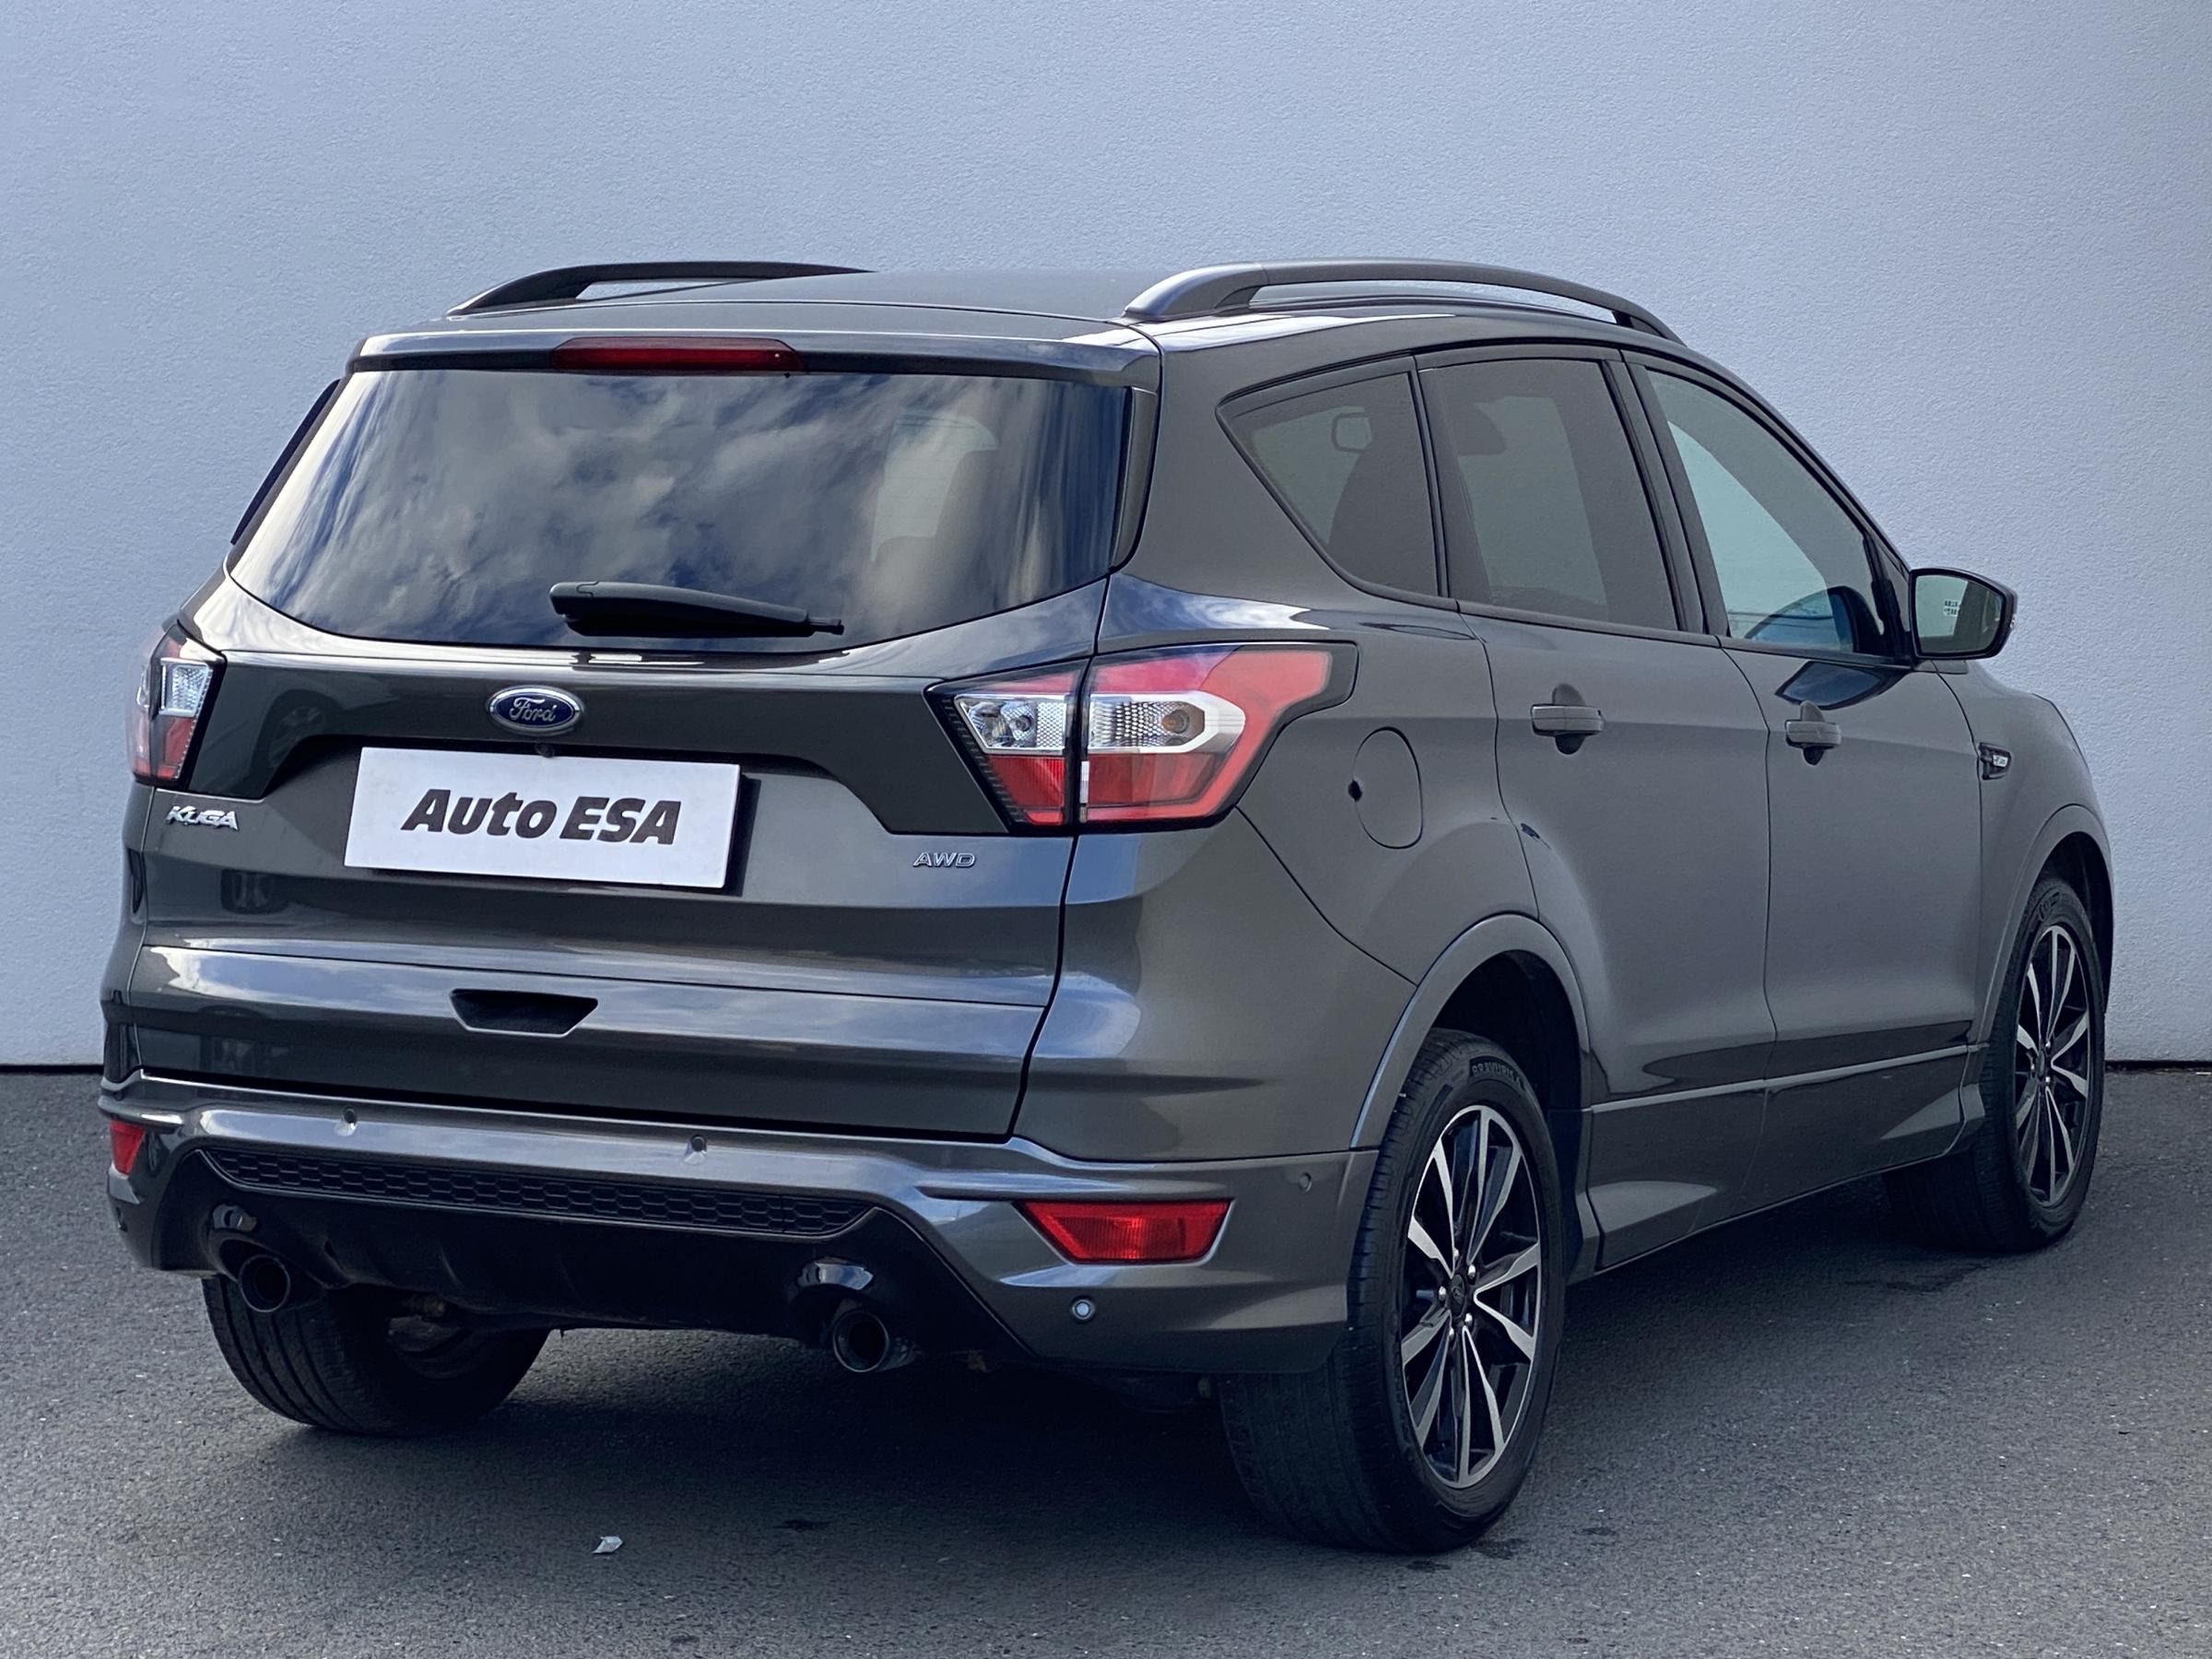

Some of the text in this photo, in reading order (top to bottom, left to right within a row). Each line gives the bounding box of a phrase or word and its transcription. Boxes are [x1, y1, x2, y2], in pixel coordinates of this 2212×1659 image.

[509, 696, 559, 722] Ford
[166, 806, 239, 830] KUGA
[400, 788, 682, 845] Auto ESA
[912, 852, 976, 868] AWD
